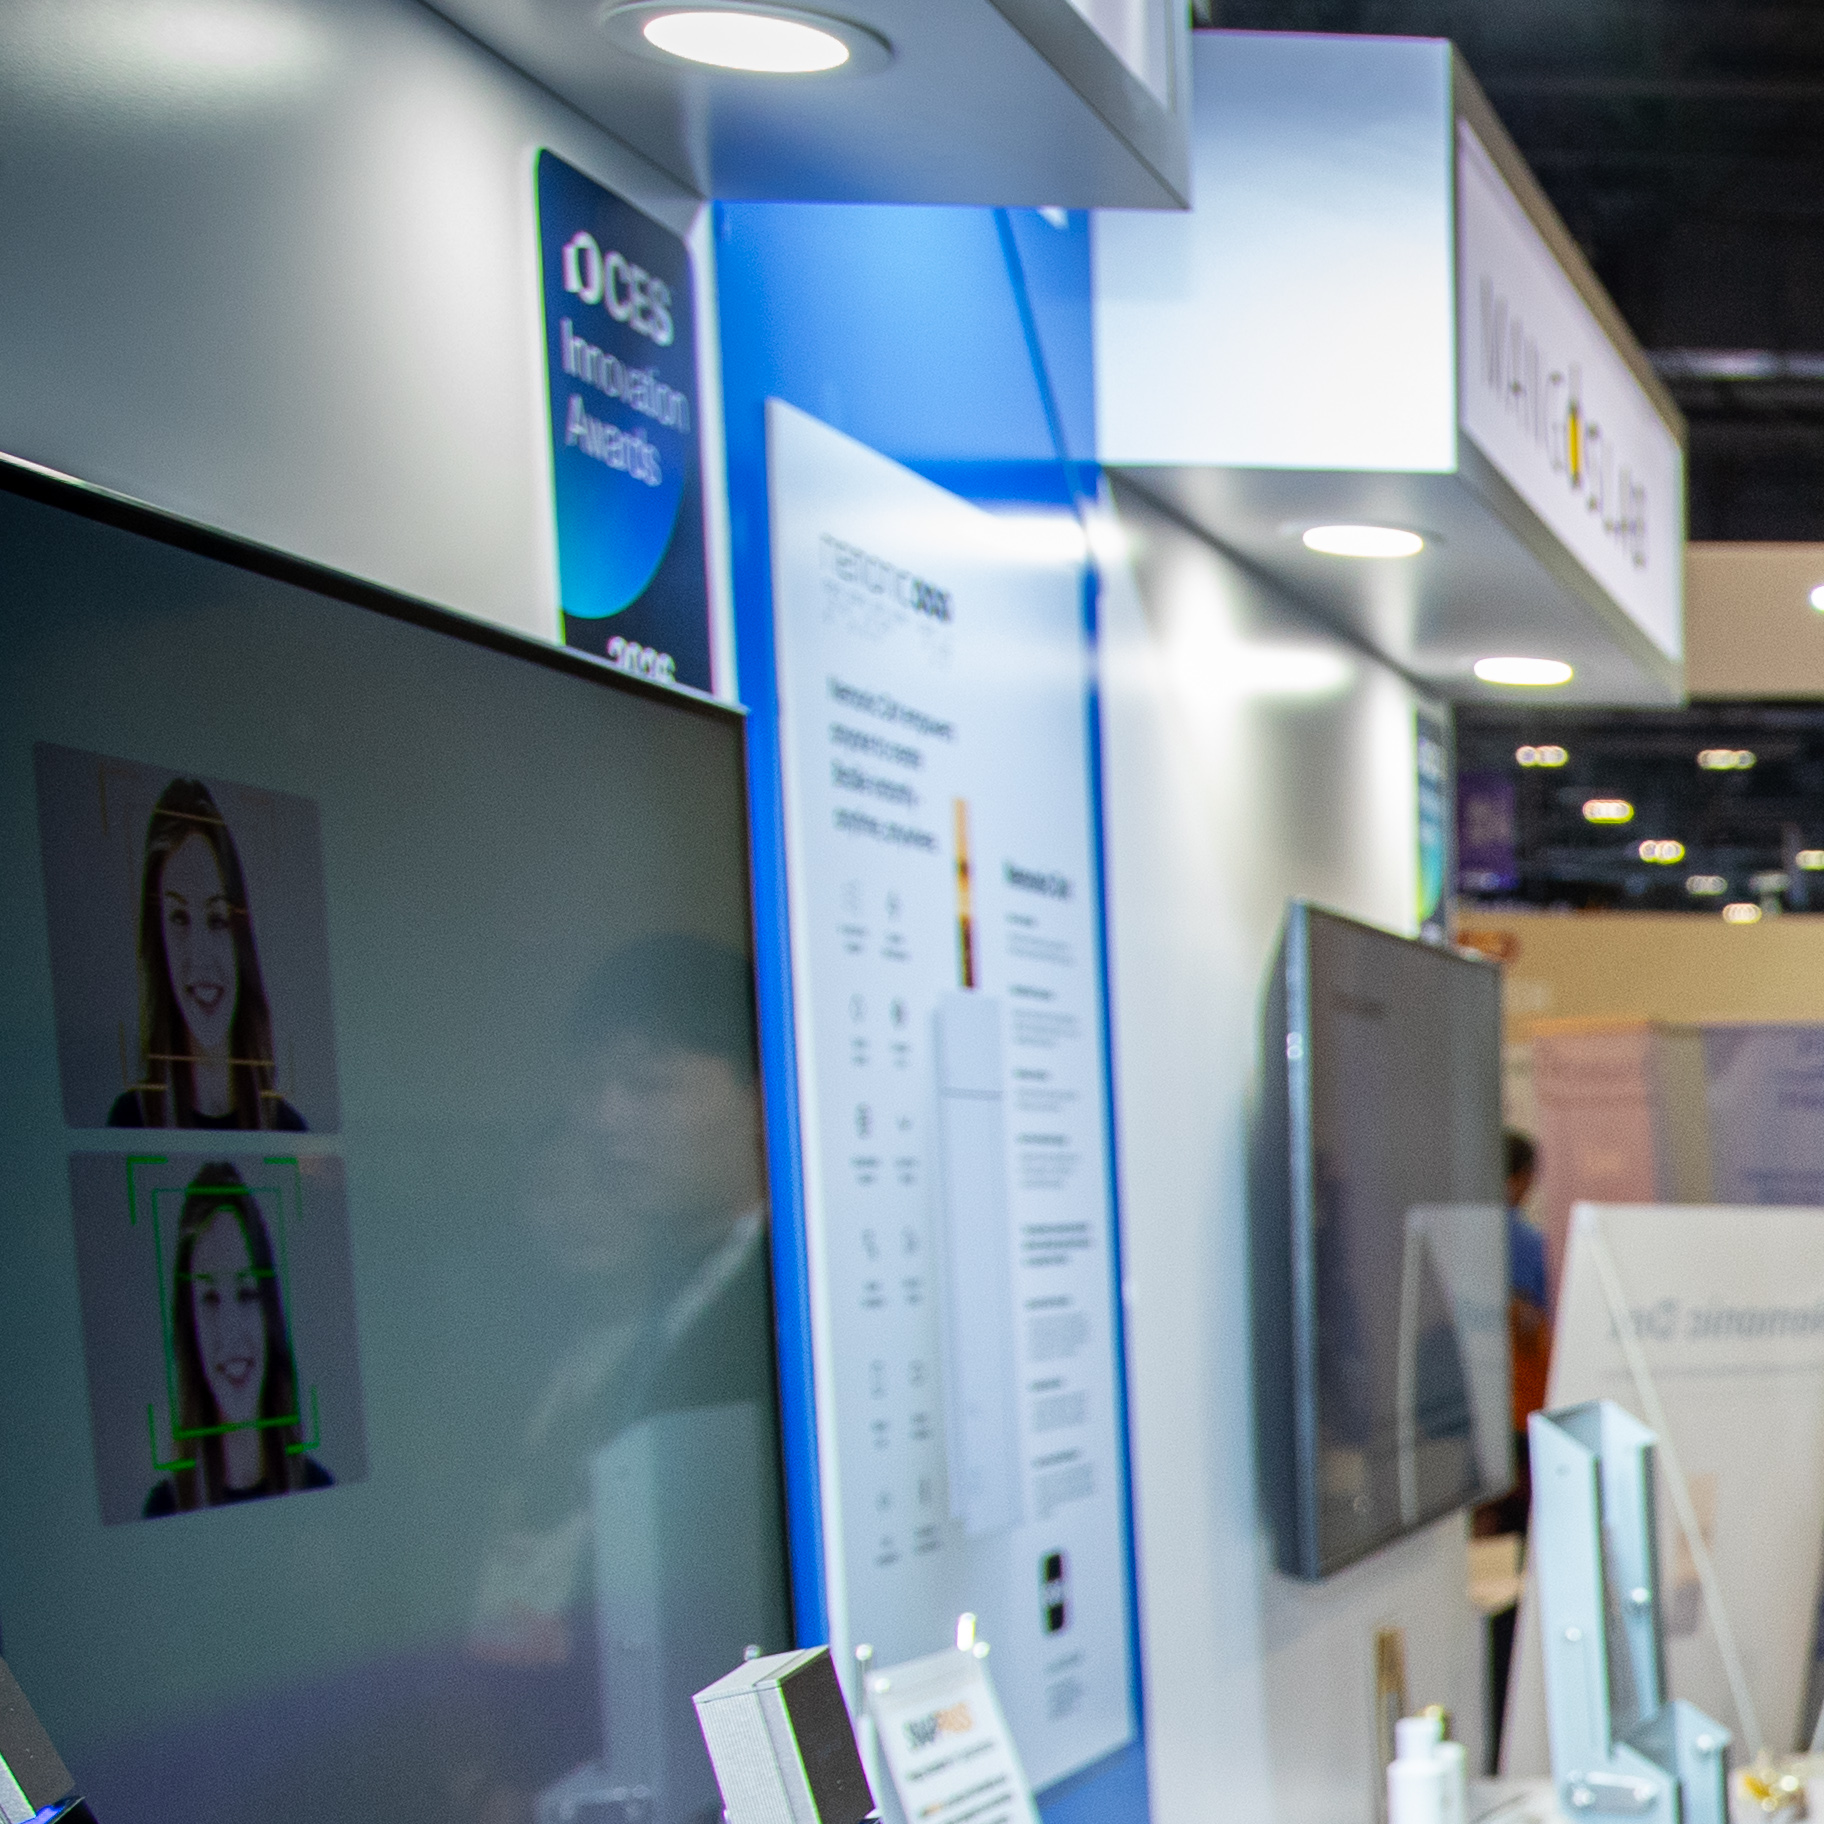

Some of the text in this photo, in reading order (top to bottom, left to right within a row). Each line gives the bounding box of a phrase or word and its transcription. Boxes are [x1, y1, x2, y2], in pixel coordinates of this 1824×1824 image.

[602, 250, 674, 347] CES
[559, 316, 692, 435] Innovation
[564, 392, 663, 488] Awards
